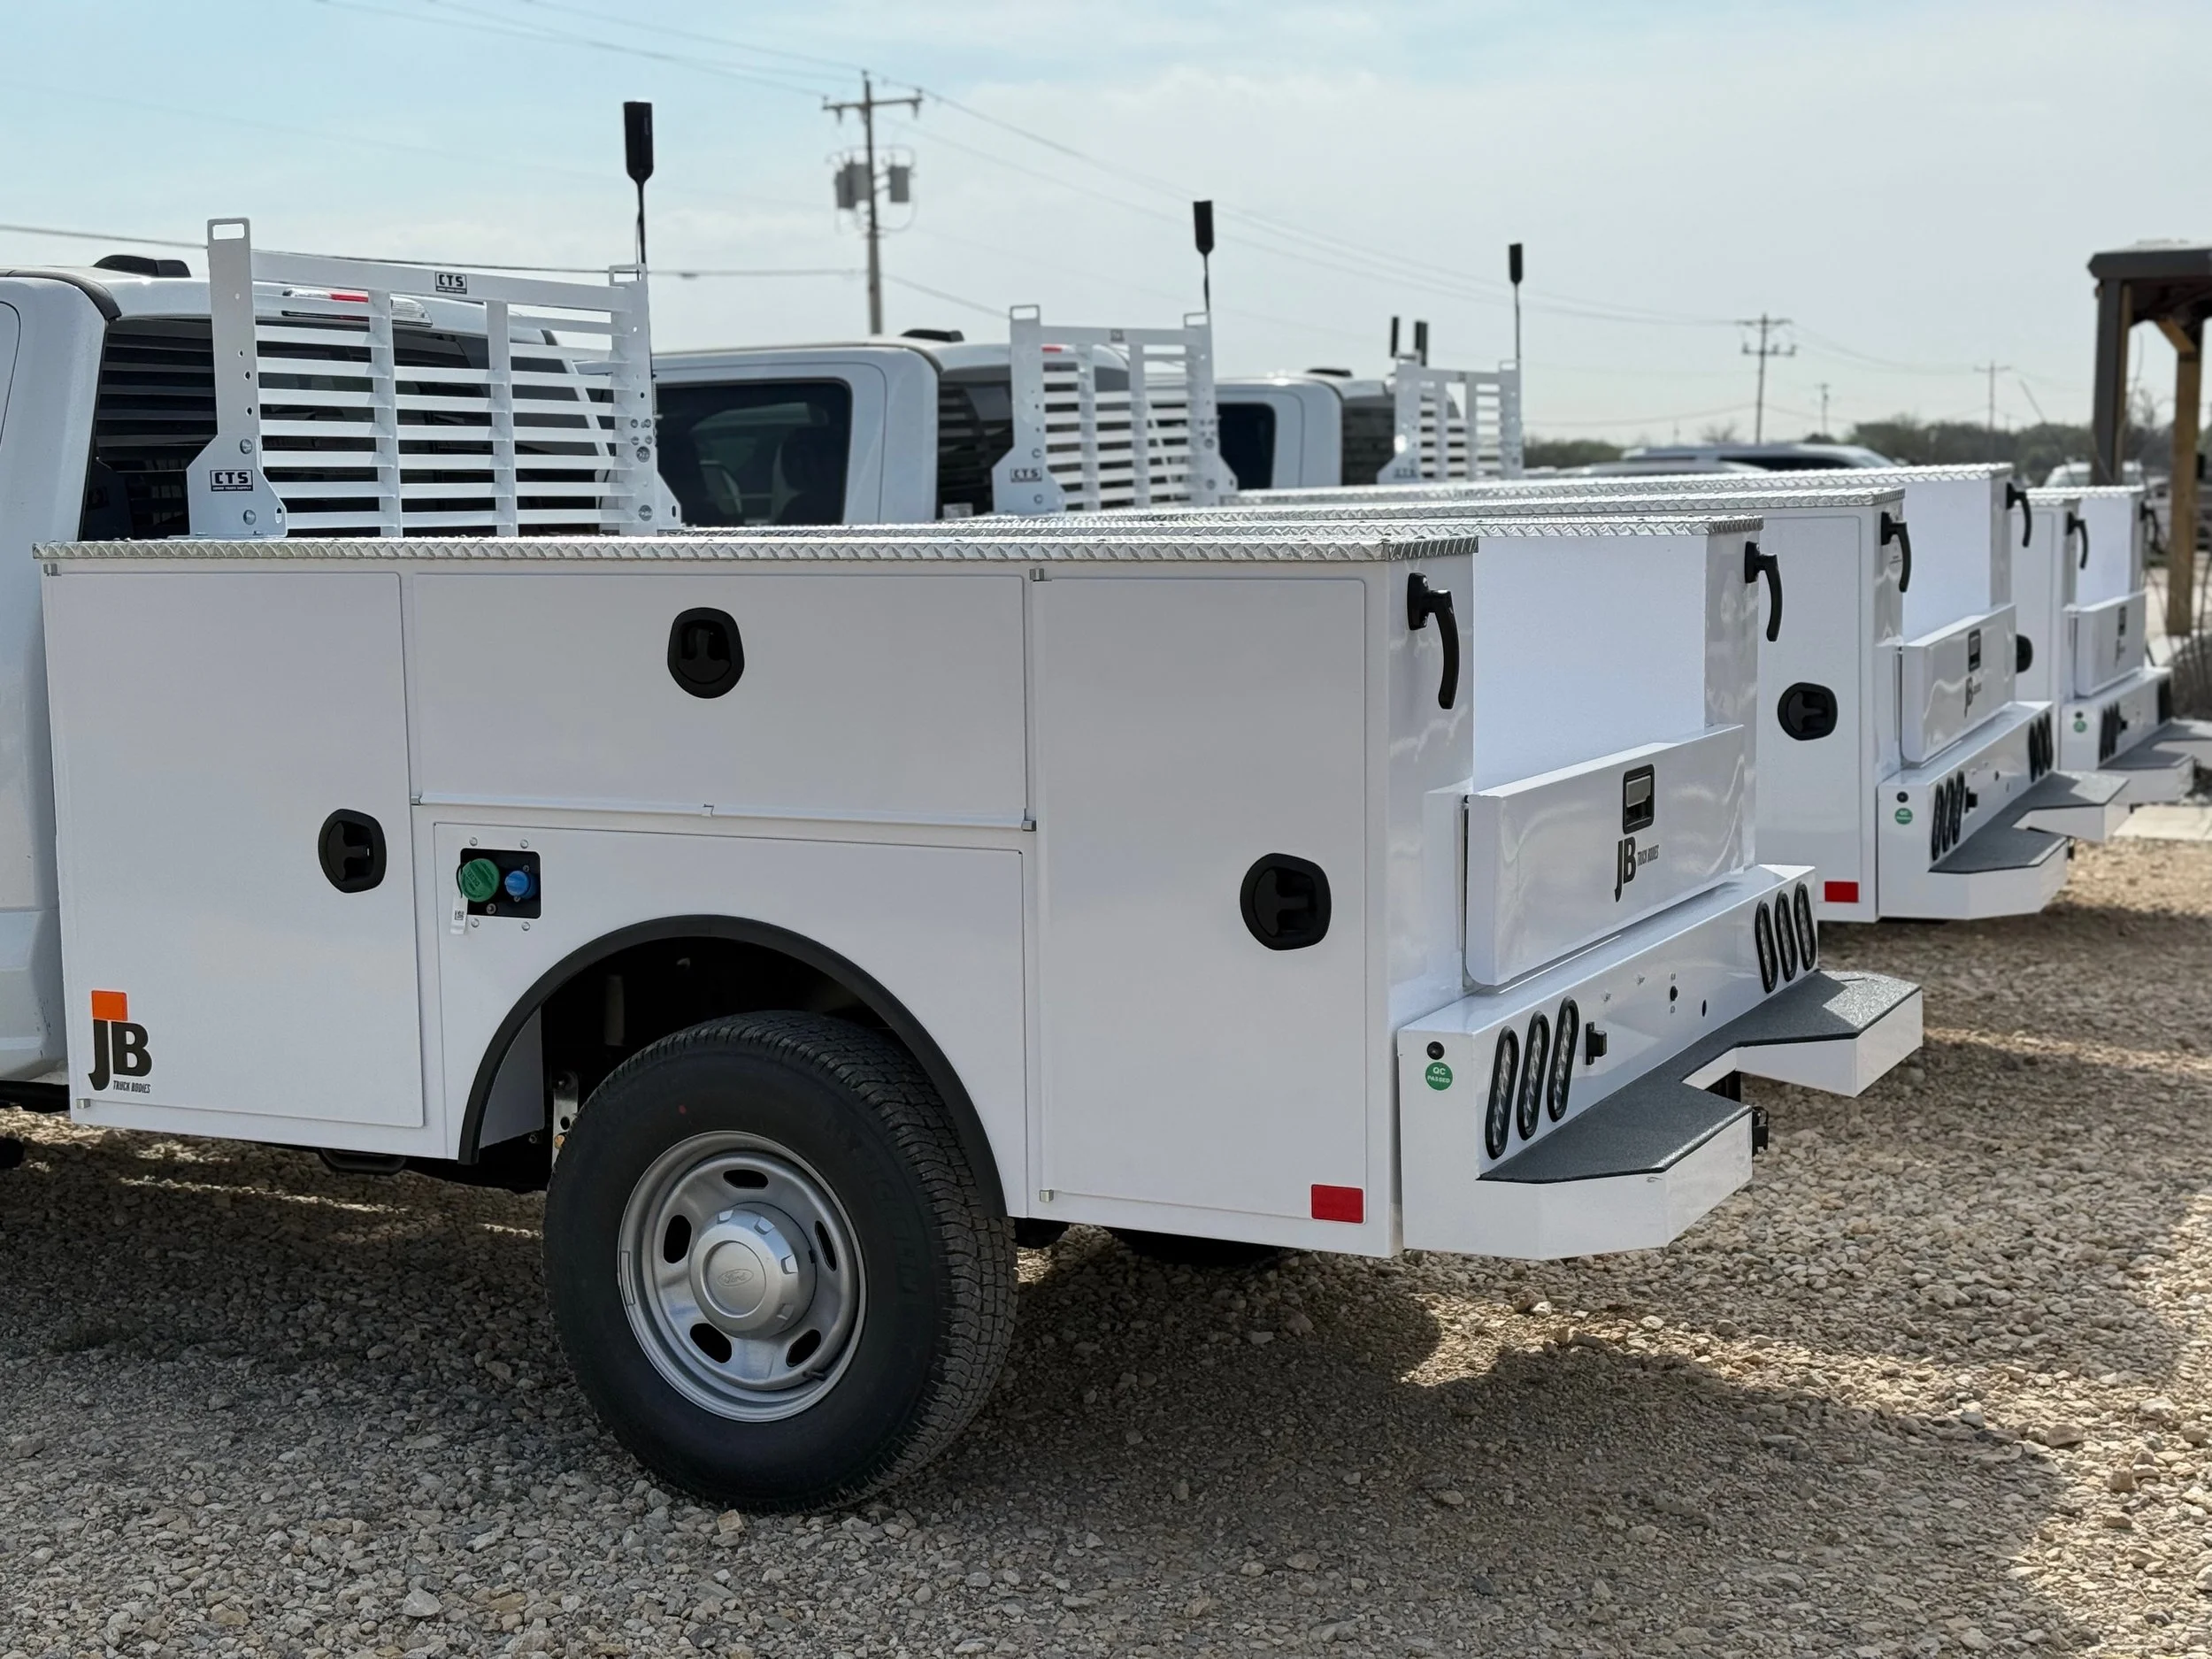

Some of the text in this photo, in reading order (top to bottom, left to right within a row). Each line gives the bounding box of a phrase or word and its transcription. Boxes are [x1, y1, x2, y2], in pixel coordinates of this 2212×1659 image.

[438, 273, 464, 288] CTS
[214, 472, 249, 484] CTS
[1614, 836, 1637, 902] JB
[88, 1018, 153, 1092] JB
[1432, 1066, 1447, 1076] QC
[112, 1079, 151, 1094] TRUCK BODIES
[1426, 1074, 1451, 1084] PASSED
